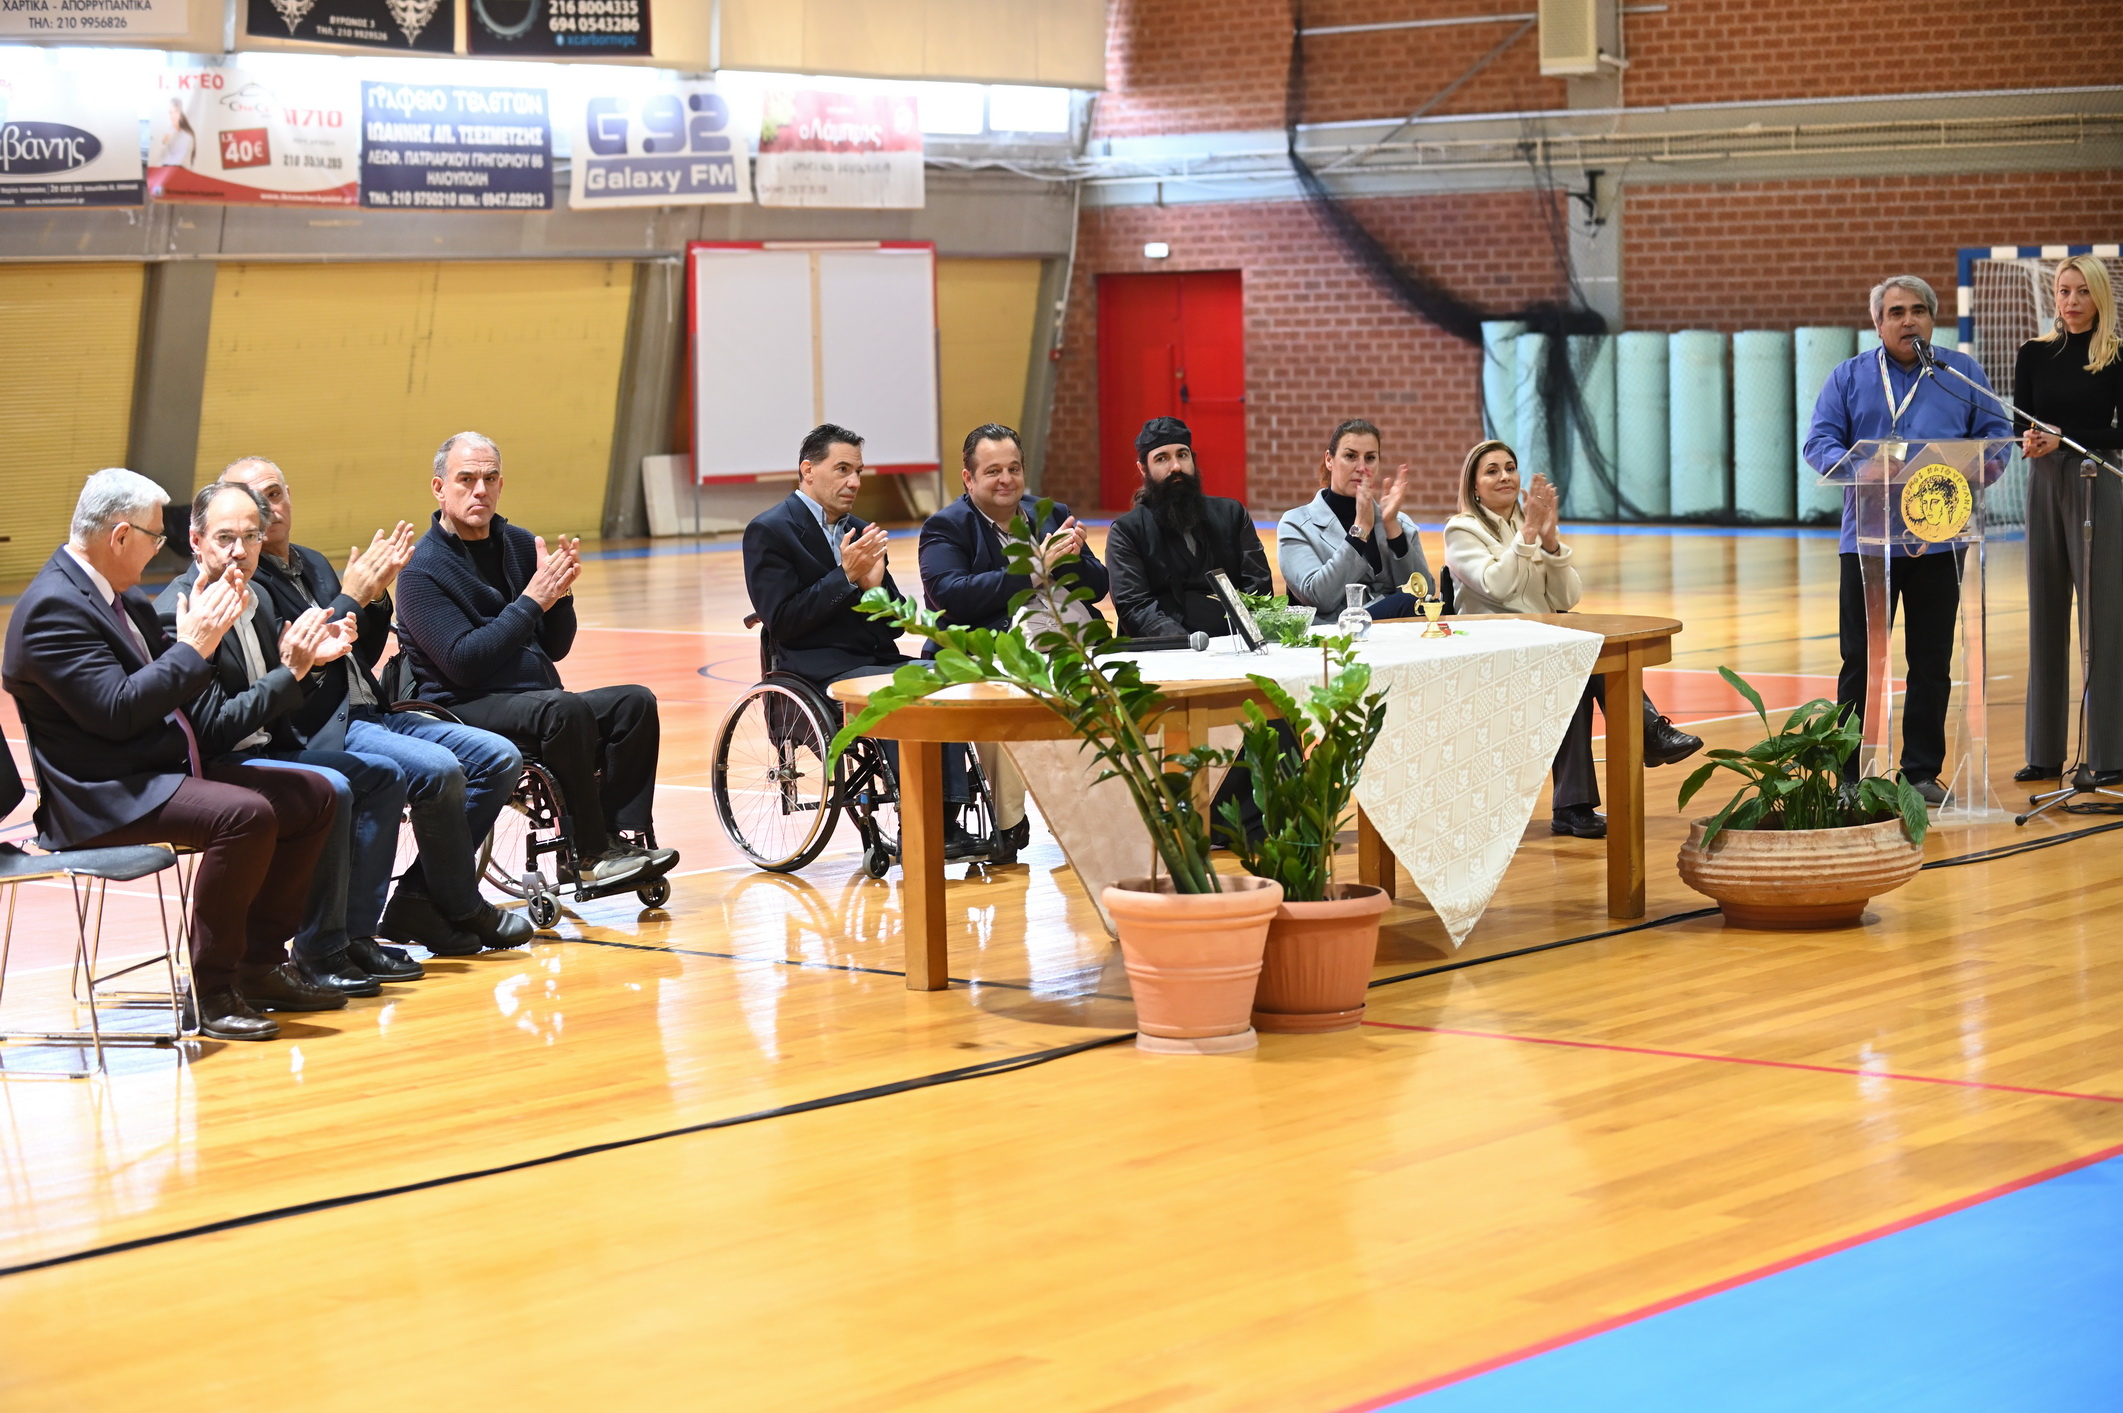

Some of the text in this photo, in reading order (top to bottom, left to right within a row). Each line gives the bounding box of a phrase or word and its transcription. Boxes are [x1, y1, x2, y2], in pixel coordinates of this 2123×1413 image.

[3, 0, 49, 11] ΧΑΡΤΙΚΑ
[61, 0, 152, 11] ΑΠΟΡΡΥΠΑΝΤΙΚΑ
[549, 0, 639, 15] 216 8004335
[29, 17, 128, 28] ΤΗΛ: 210 9956826
[549, 16, 640, 32] 694 0543286
[336, 27, 353, 38] 210
[367, 121, 432, 143] ΙΩΑΝΝΗΣ
[0, 125, 86, 171] βάνης
[225, 139, 264, 163] 40€
[368, 149, 402, 165] ΛΕΩΦ.
[404, 150, 470, 167] ΠΑΤΡΙΑΡΧΟΥ
[472, 152, 530, 168] ΓΡΗΓΟΡΙΟΥ
[427, 171, 488, 186] ΗΛΙΟΥΠΟΛΗ
[587, 163, 734, 193] Galaxy FM
[392, 191, 411, 206] 210
